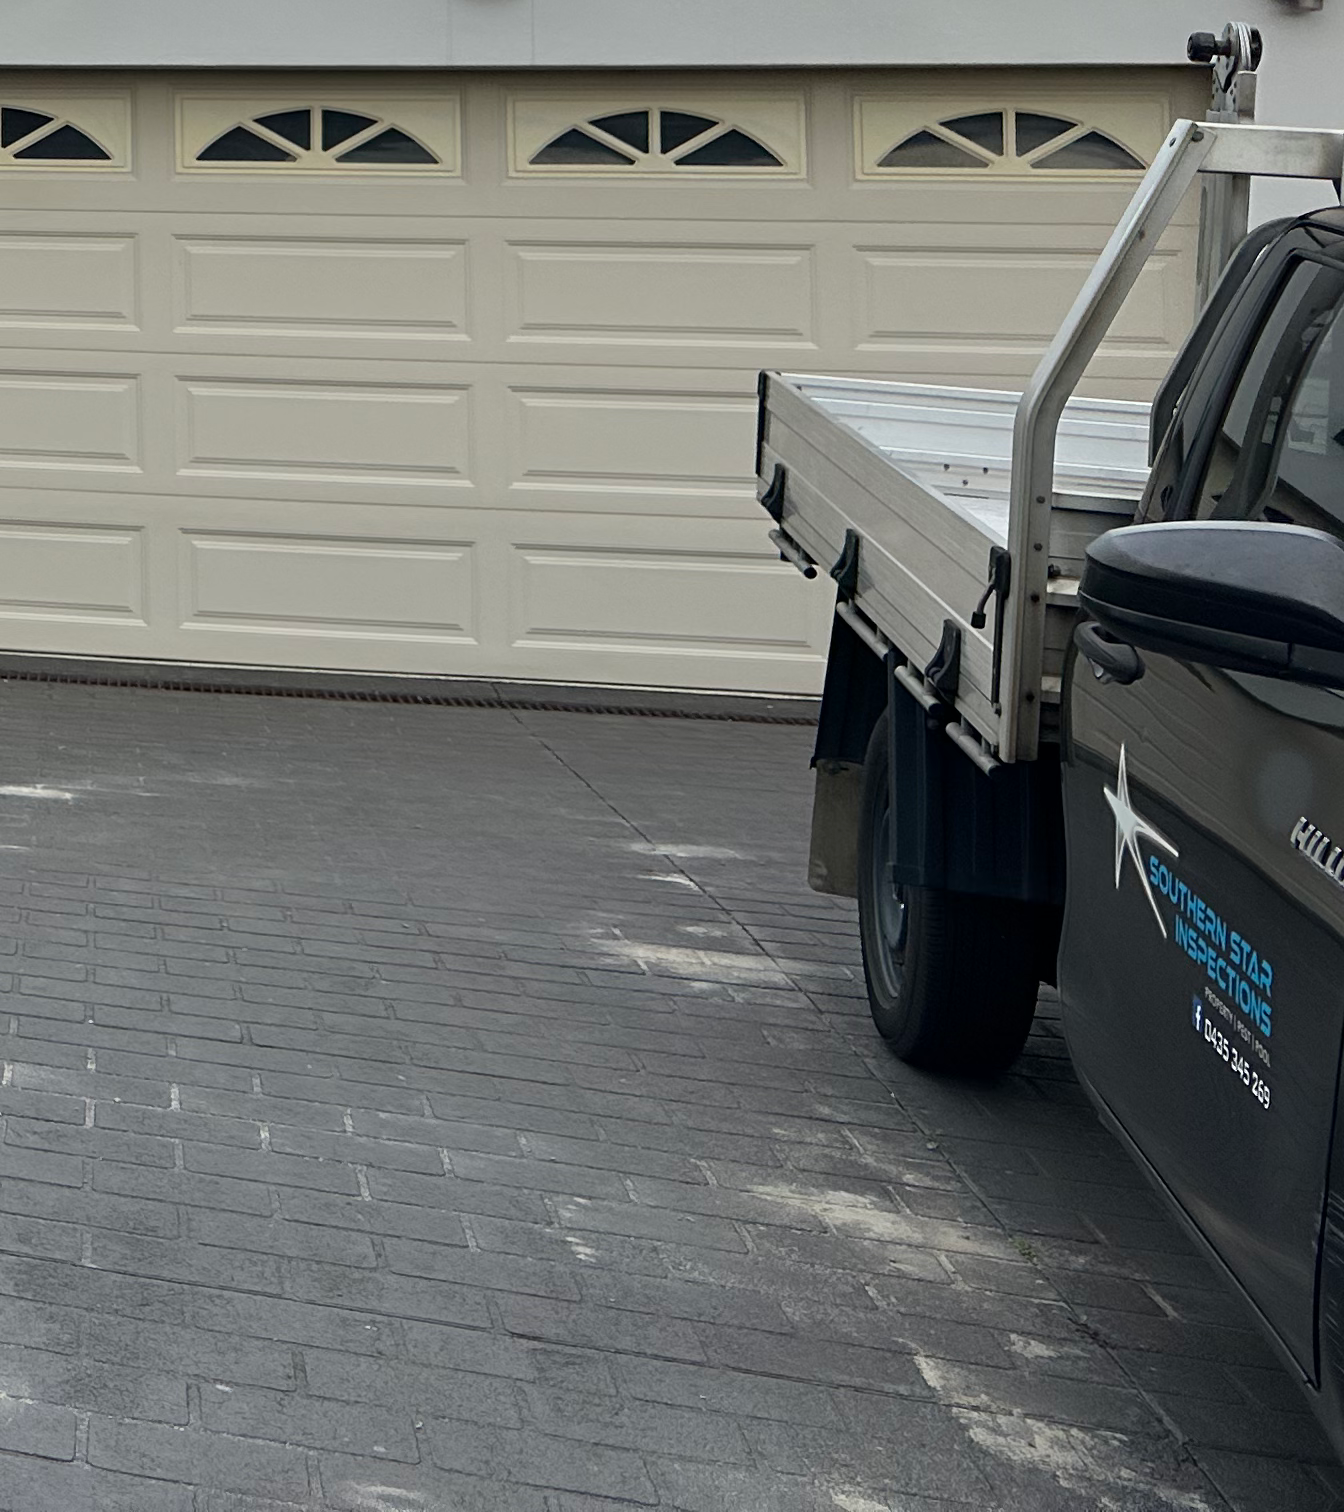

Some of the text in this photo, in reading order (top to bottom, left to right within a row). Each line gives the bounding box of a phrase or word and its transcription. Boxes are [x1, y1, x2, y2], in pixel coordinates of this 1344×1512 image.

[1149, 855, 1273, 998] SOUTHERN STAR
[1174, 914, 1272, 1038] INSPECTIONS
[1204, 1018, 1271, 1109] 0435 345 269
